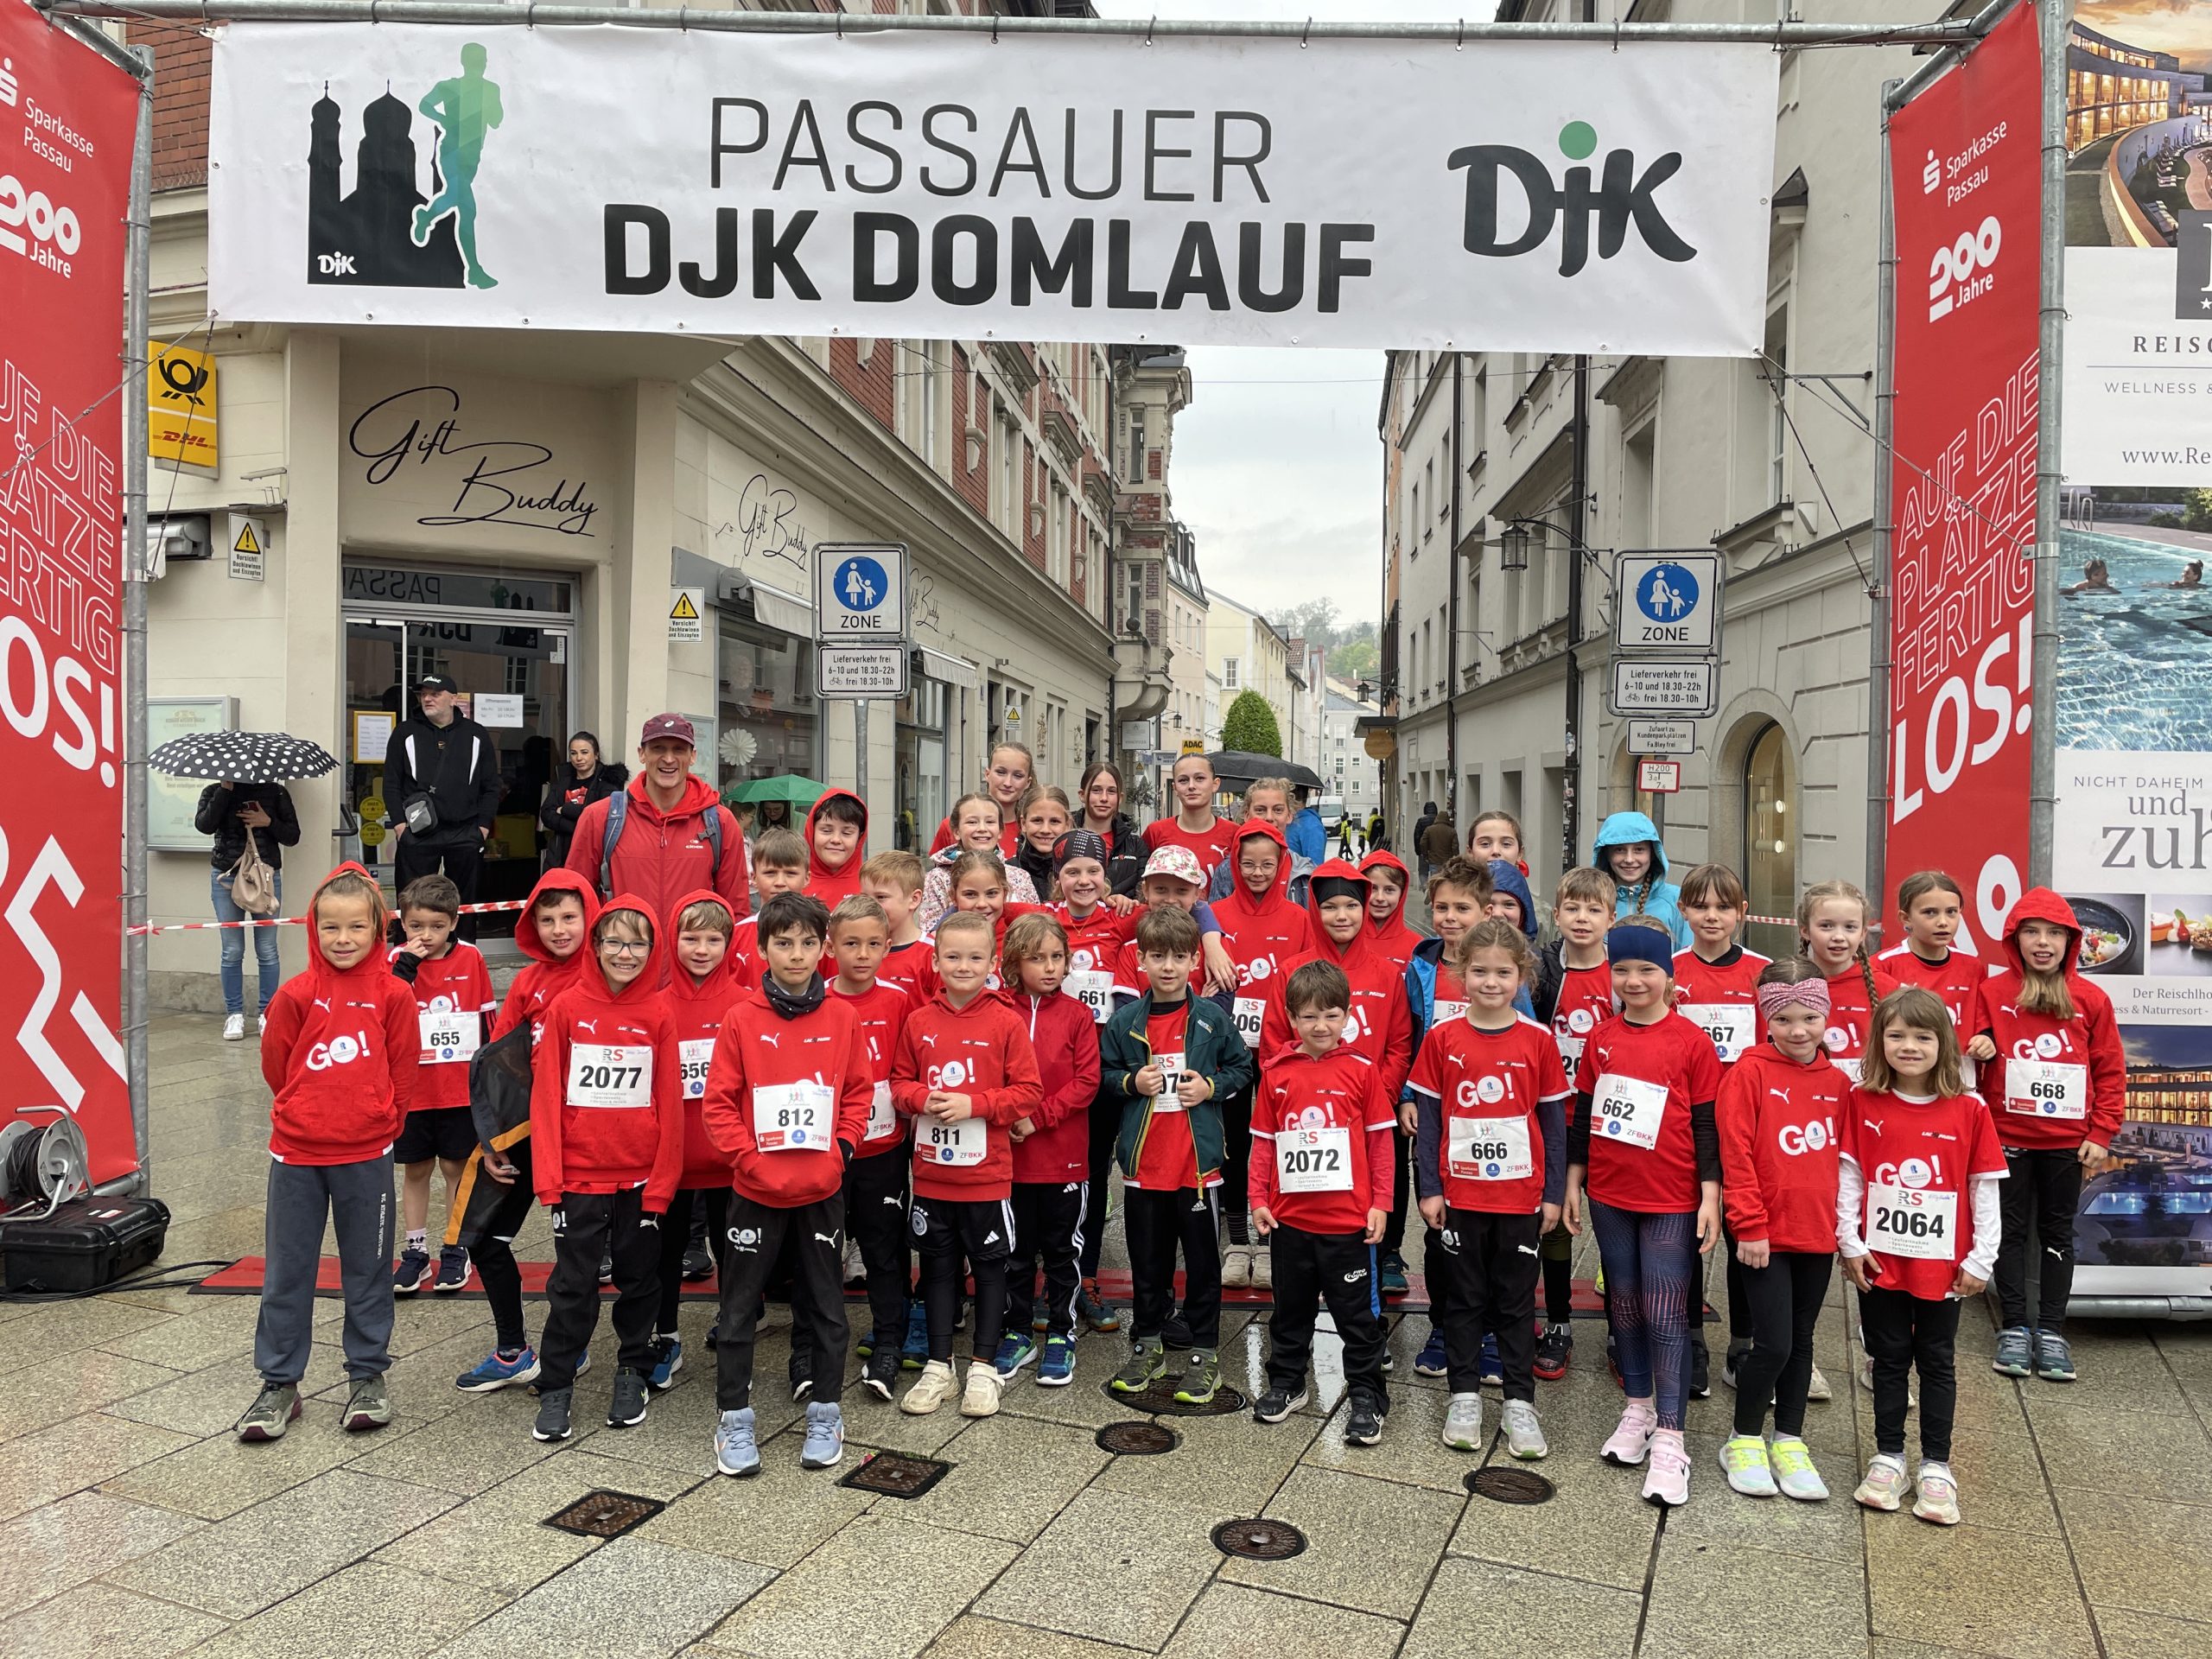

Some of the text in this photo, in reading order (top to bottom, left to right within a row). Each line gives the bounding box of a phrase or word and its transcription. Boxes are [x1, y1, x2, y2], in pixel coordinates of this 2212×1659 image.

[25, 97, 94, 158] Sparkasse
[24, 126, 72, 173] Passau
[711, 97, 1271, 204] PASSAUER
[1947, 121, 2006, 179] Sparkasse
[1948, 166, 1988, 207] Passau
[29, 241, 72, 278] Jahre
[605, 204, 1375, 313] DJK DOMLAUF
[1929, 216, 2002, 323] 200
[1956, 273, 1993, 308] Jahre
[2105, 382, 2196, 394] WELLNESS
[162, 430, 208, 448] DHL
[349, 386, 599, 537] Gift Buddy
[1898, 348, 2039, 559] AUF DIE
[52, 405, 114, 521] DIE
[0, 432, 114, 596] ÄTZE
[739, 474, 808, 572] Gift Buddy
[1897, 431, 2038, 634] PLÄTZE
[841, 615, 881, 628] ZONE
[1897, 518, 2036, 711] FERTIG
[1642, 627, 1689, 640] ZONE
[1630, 670, 1681, 678] Lieferverkehr
[1645, 682, 1659, 690] und
[1644, 694, 1657, 702] frei
[1893, 610, 2032, 825] LOS!
[2075, 777, 2202, 788] NICHT DAHEIM
[2128, 789, 2188, 815] und
[1078, 990, 1105, 1006] 661
[2133, 988, 2154, 999] Der
[1243, 1000, 1259, 1011] RS
[2131, 1005, 2139, 1014] &
[2143, 1006, 2202, 1015] Naturresort
[430, 1032, 460, 1046] 655
[602, 1048, 624, 1061] RS
[1158, 1056, 1175, 1068] RS
[579, 1065, 642, 1089] 2077
[2031, 1082, 2065, 1100] 668
[778, 1109, 814, 1127] 812
[1602, 1097, 1636, 1122] 662
[873, 1123, 893, 1132] ZFBKK
[1627, 1128, 1654, 1141] ZFBKK
[1778, 1116, 1836, 1156] GO!
[931, 1128, 960, 1146] 811
[1299, 1131, 1319, 1144] RS
[1471, 1142, 1508, 1160] 666
[1284, 1148, 1340, 1173] 2072
[1506, 1164, 1529, 1173] ZFBKK
[1897, 1190, 1923, 1206] RS
[1876, 1206, 1944, 1238] 2064
